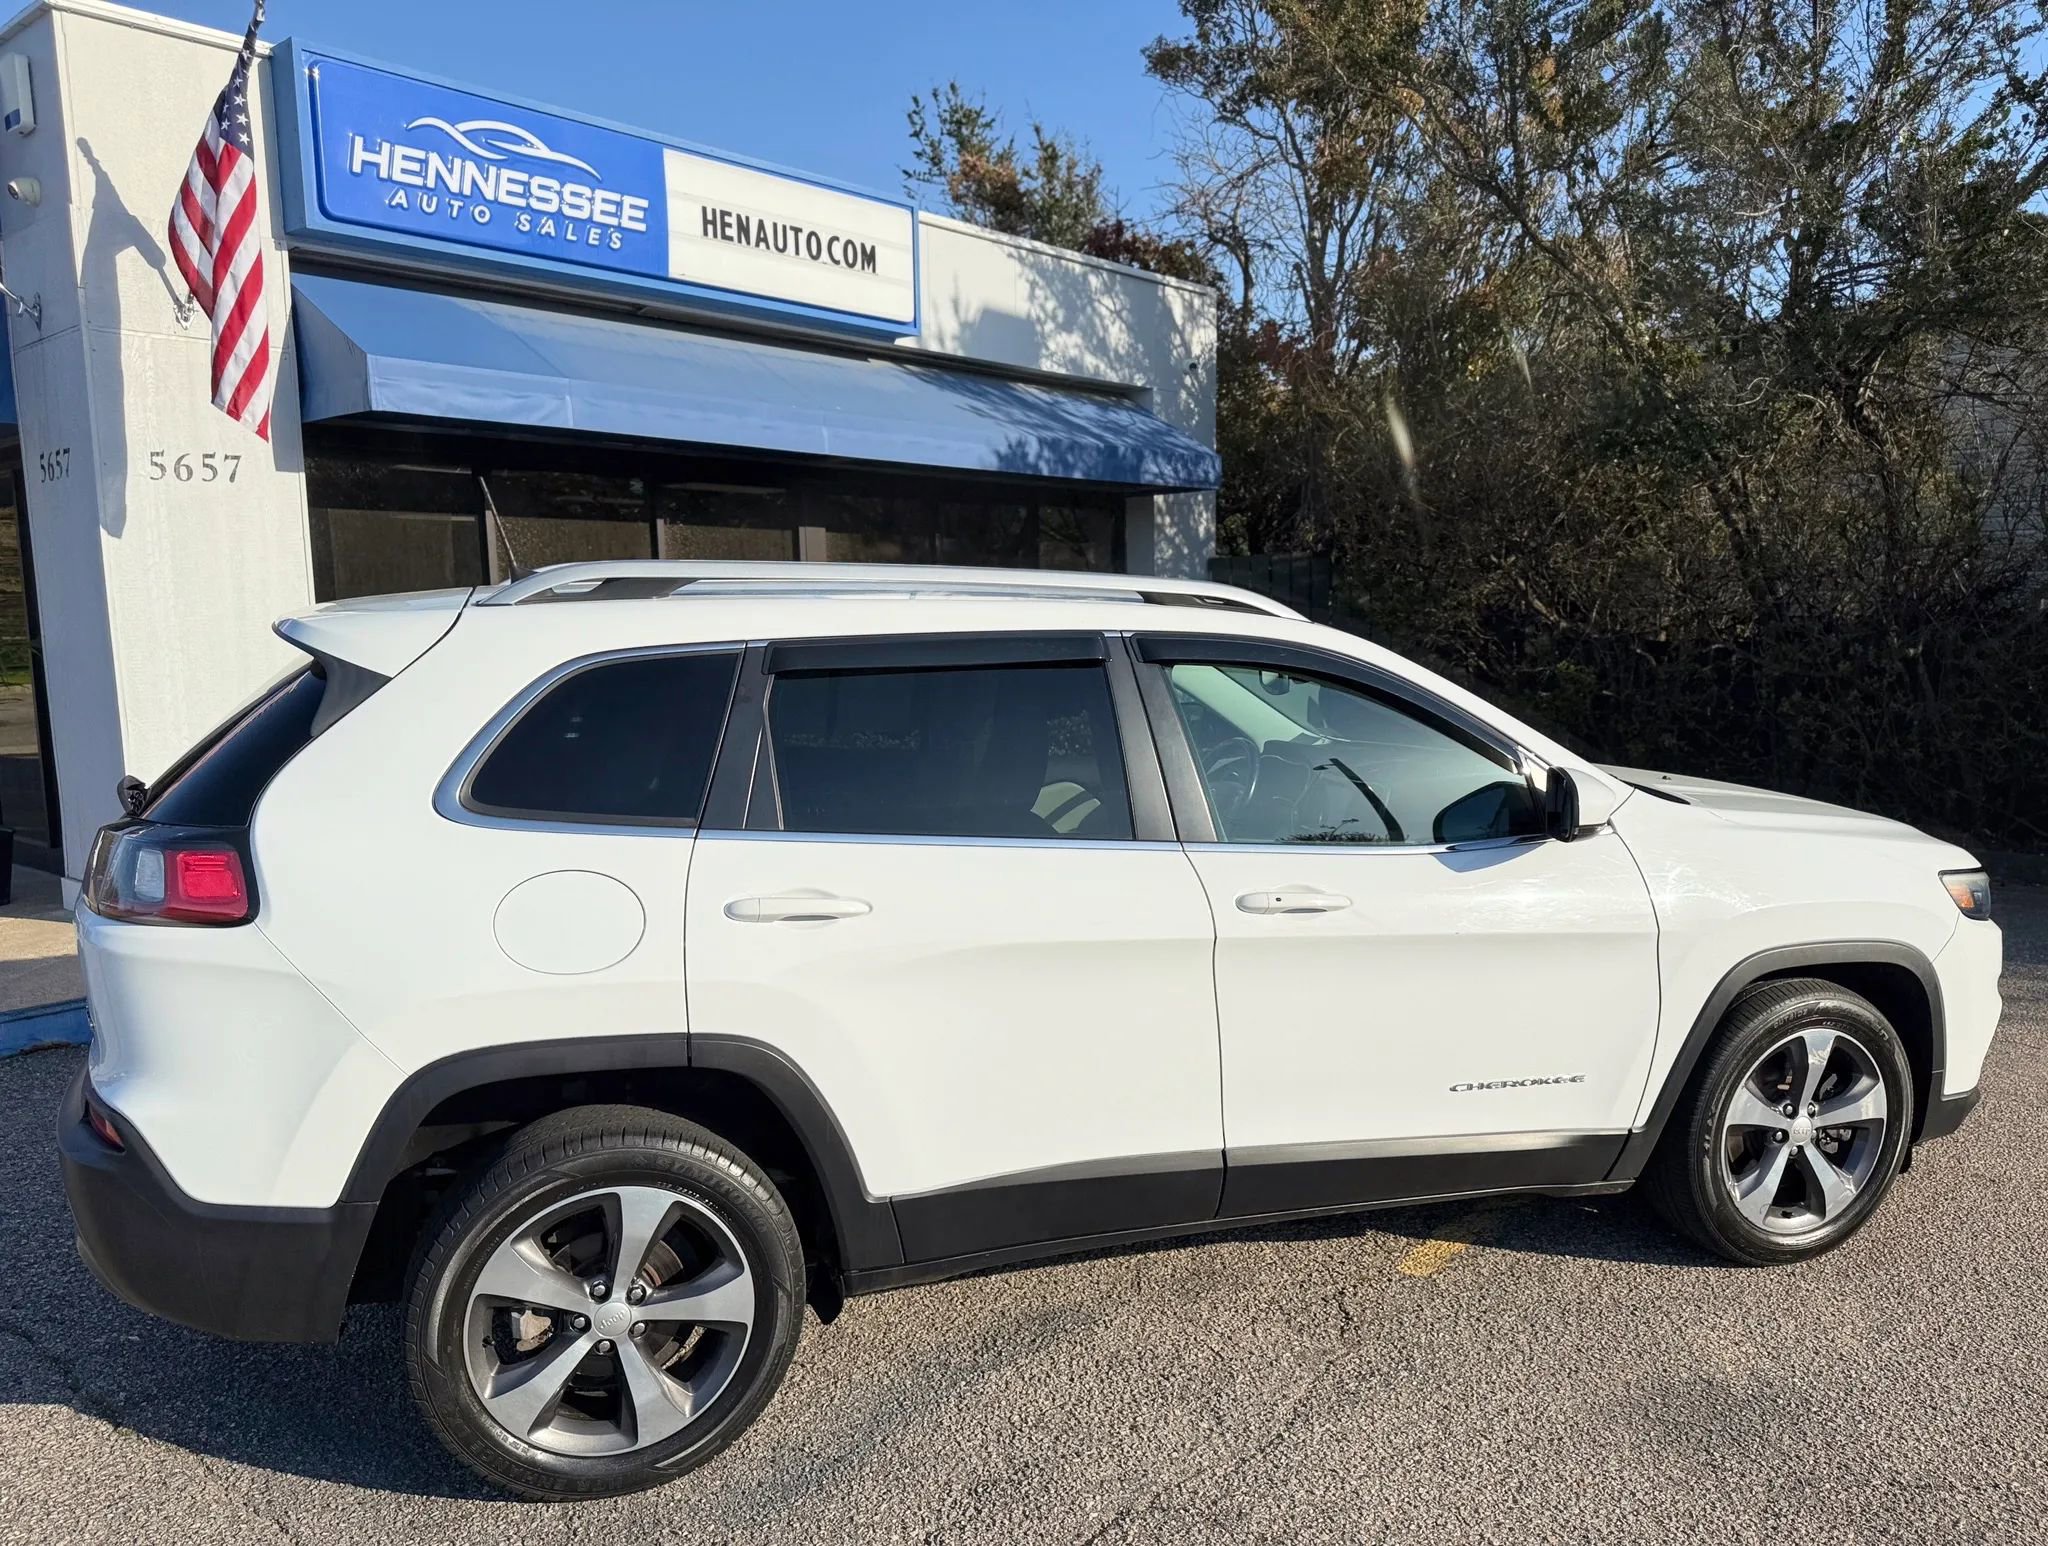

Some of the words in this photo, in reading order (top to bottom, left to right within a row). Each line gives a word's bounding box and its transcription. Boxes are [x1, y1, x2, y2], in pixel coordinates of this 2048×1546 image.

[351, 134, 650, 233] HENNESSEE
[387, 187, 492, 225] AUTO
[515, 212, 624, 250] SALES
[39, 447, 71, 484] 5657
[149, 449, 242, 484] 5657
[1449, 1074, 1587, 1093] CHEROKEE
